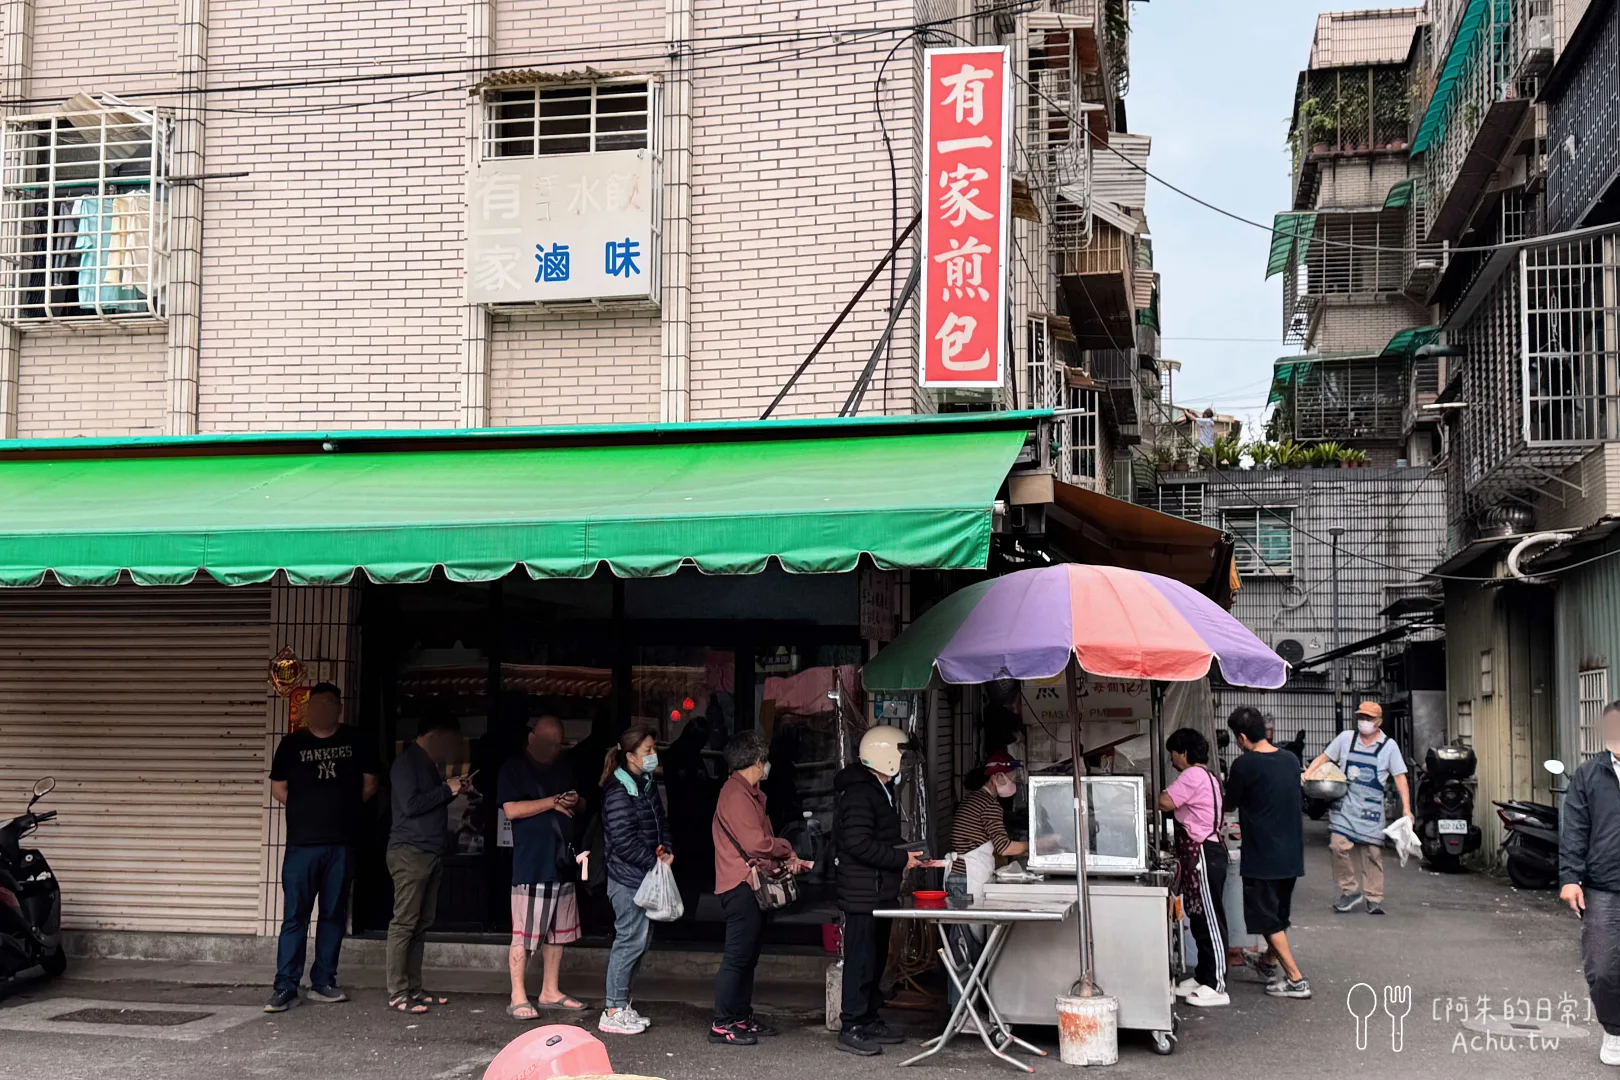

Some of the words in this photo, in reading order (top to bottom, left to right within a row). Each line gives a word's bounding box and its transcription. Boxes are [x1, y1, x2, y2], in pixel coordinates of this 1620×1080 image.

[471, 171, 523, 292] 有一家
[933, 63, 995, 372] 有一家煎包
[534, 236, 642, 283] 滷味
[299, 744, 353, 763] YANKEES
[316, 760, 338, 780] NY
